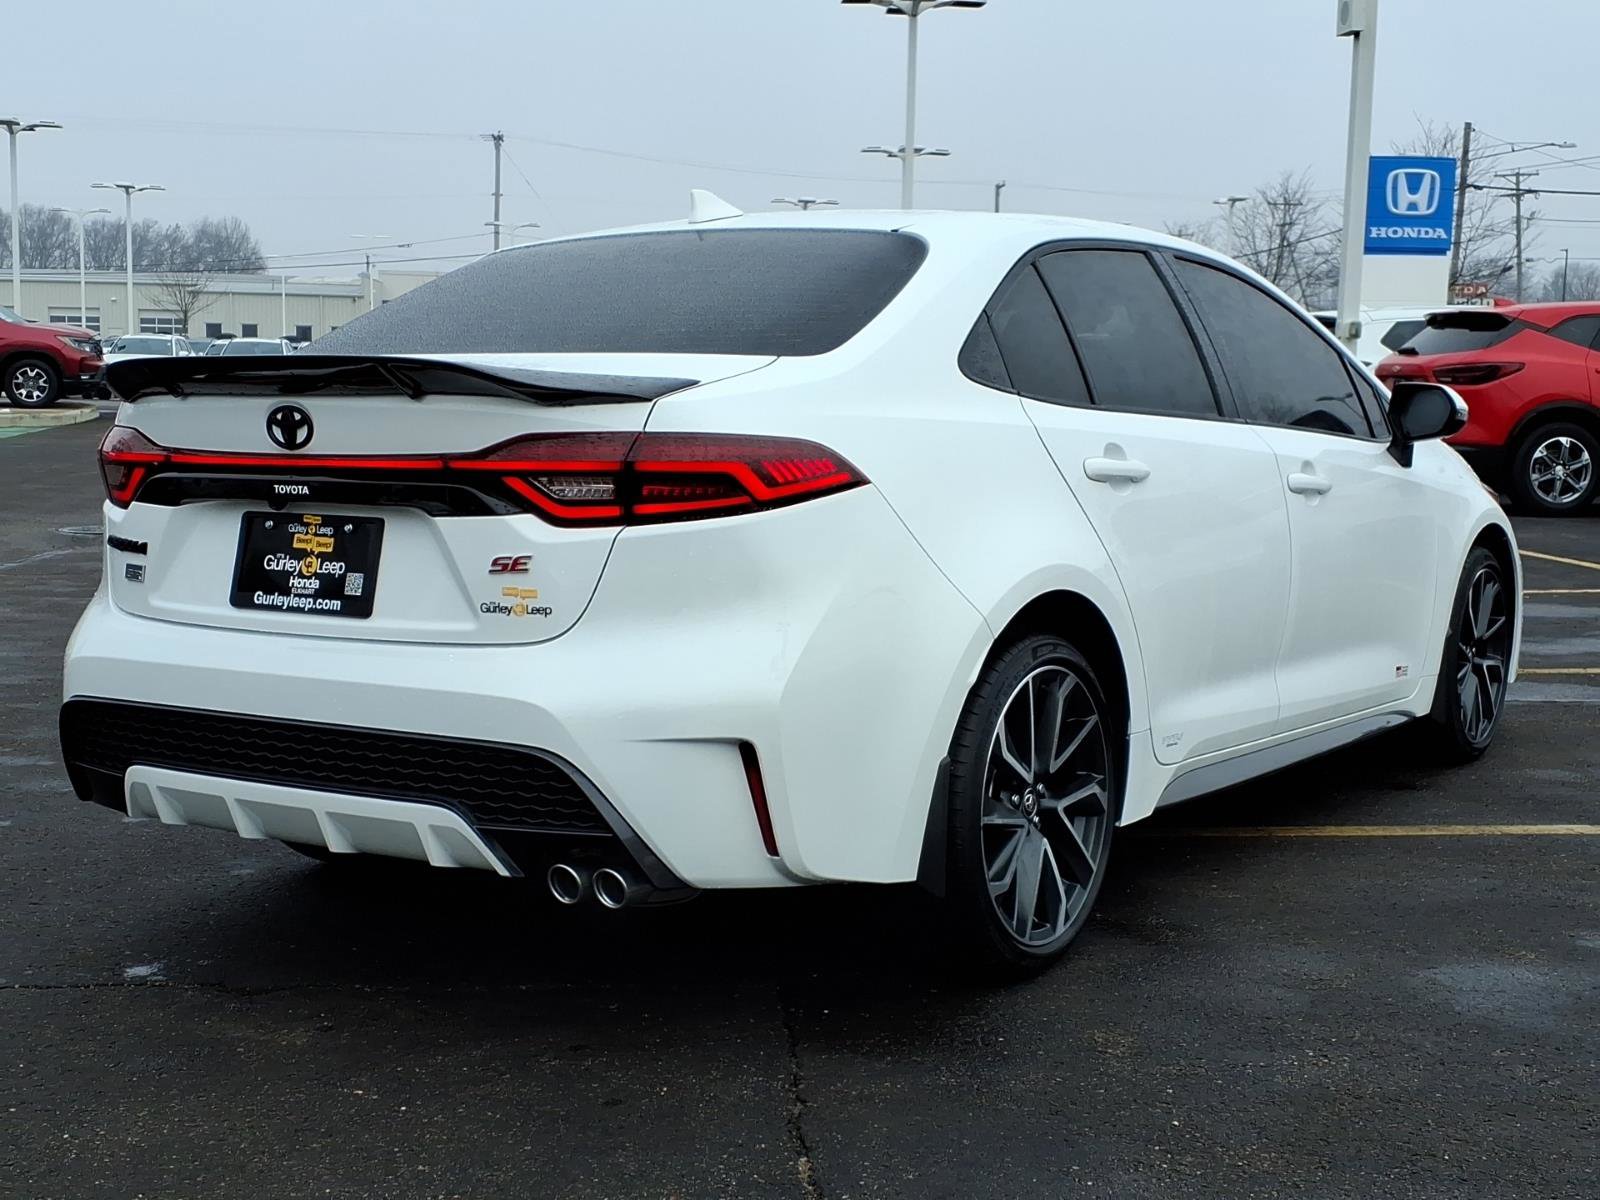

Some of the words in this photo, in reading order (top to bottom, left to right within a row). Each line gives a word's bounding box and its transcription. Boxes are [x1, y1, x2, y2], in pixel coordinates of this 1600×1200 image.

[1369, 226, 1448, 239] HONDA
[273, 484, 310, 495] TOYOTA
[316, 525, 334, 536] Leep
[264, 555, 302, 575] Gurley
[316, 558, 345, 578] Leep
[488, 554, 534, 574] SE
[289, 576, 319, 588] Honda
[254, 591, 341, 611] Gurleyleep.com
[480, 602, 513, 616] Gurley
[526, 604, 553, 618] Leep
